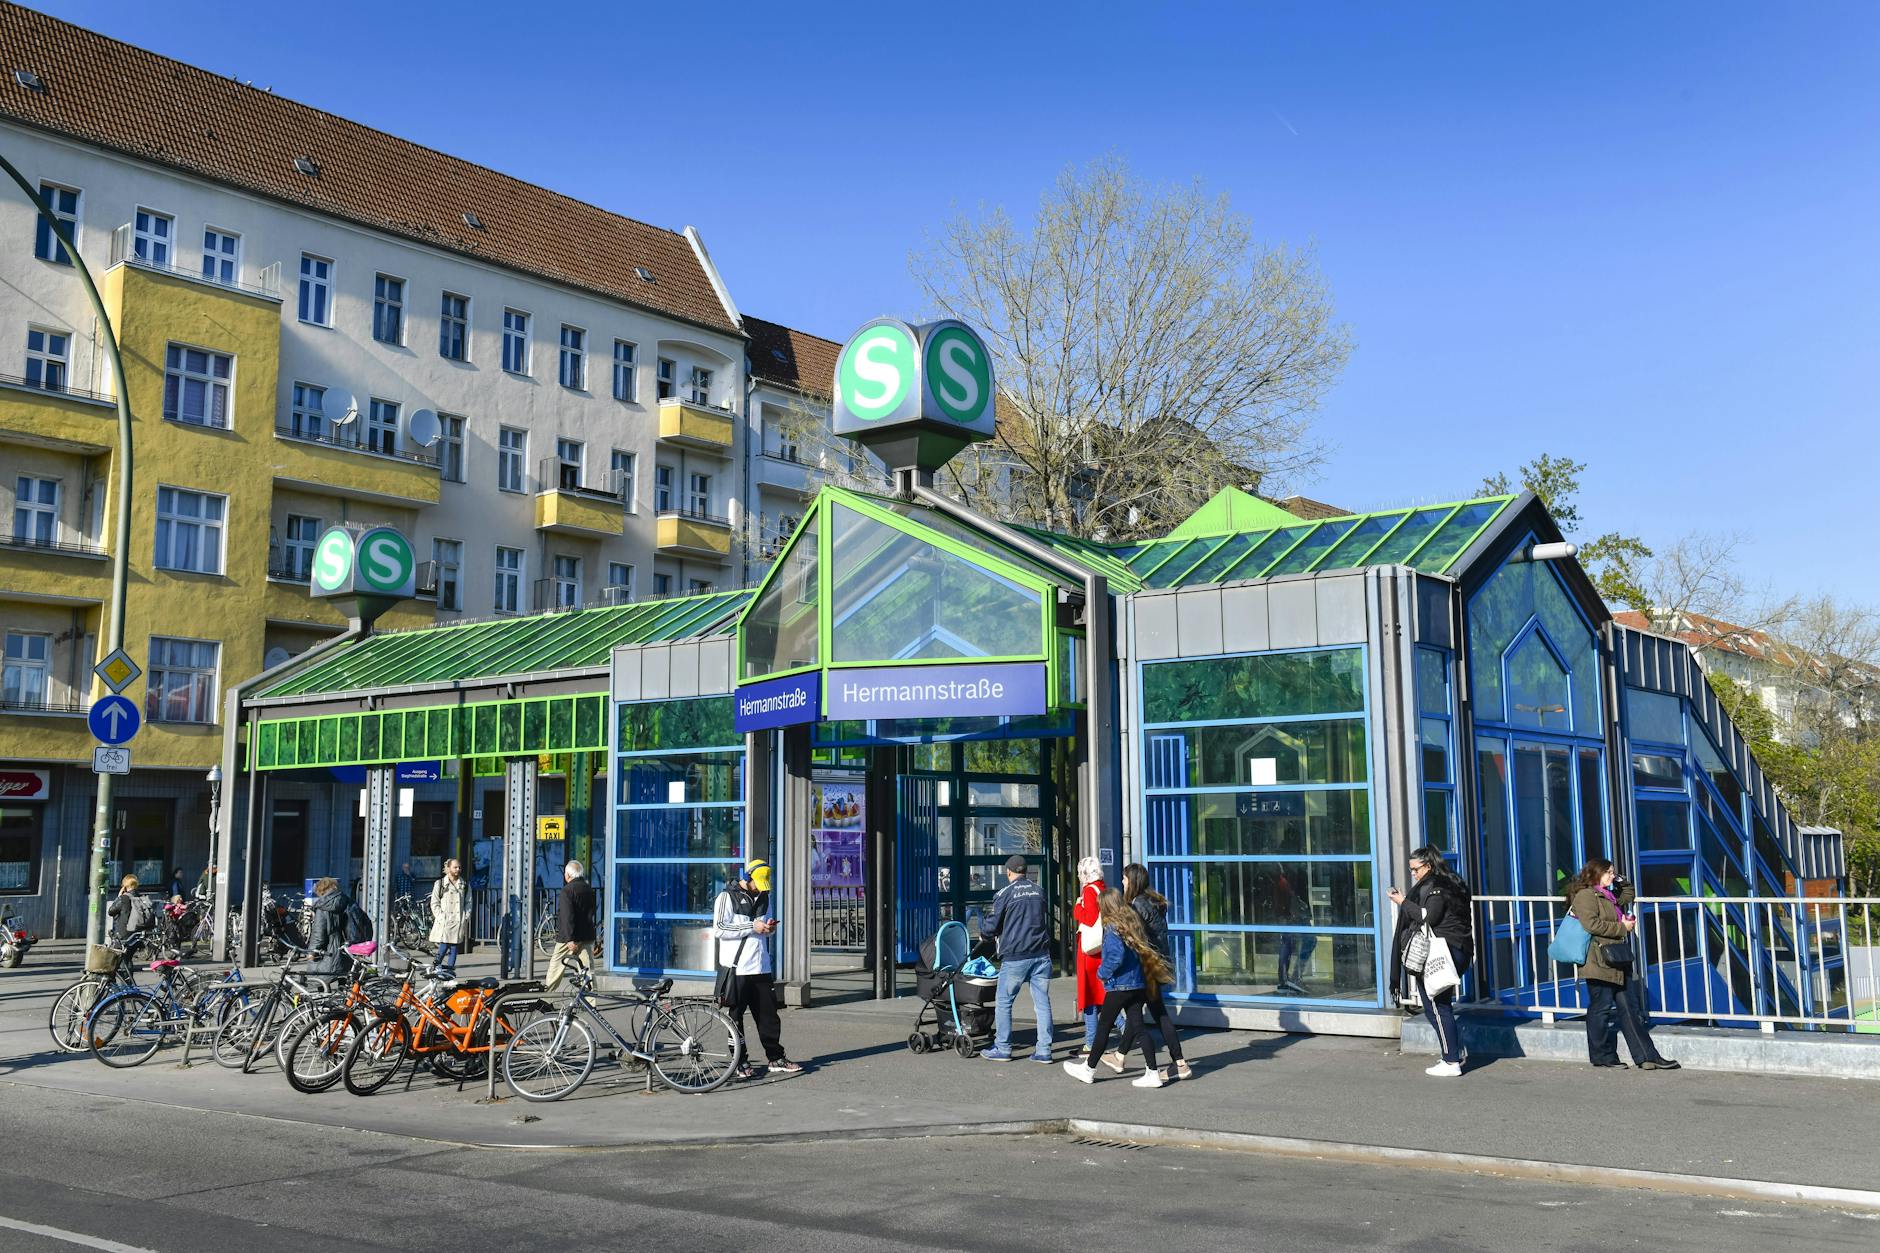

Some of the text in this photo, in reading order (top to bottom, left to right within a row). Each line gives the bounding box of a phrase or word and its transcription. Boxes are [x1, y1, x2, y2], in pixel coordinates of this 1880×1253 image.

[854, 337, 900, 409] S
[939, 338, 979, 412] S
[321, 538, 345, 583] S
[368, 538, 402, 584] S
[739, 687, 807, 717] Hermannstraße
[843, 678, 1004, 703] Hermannstraße
[544, 832, 560, 840] TAXI
